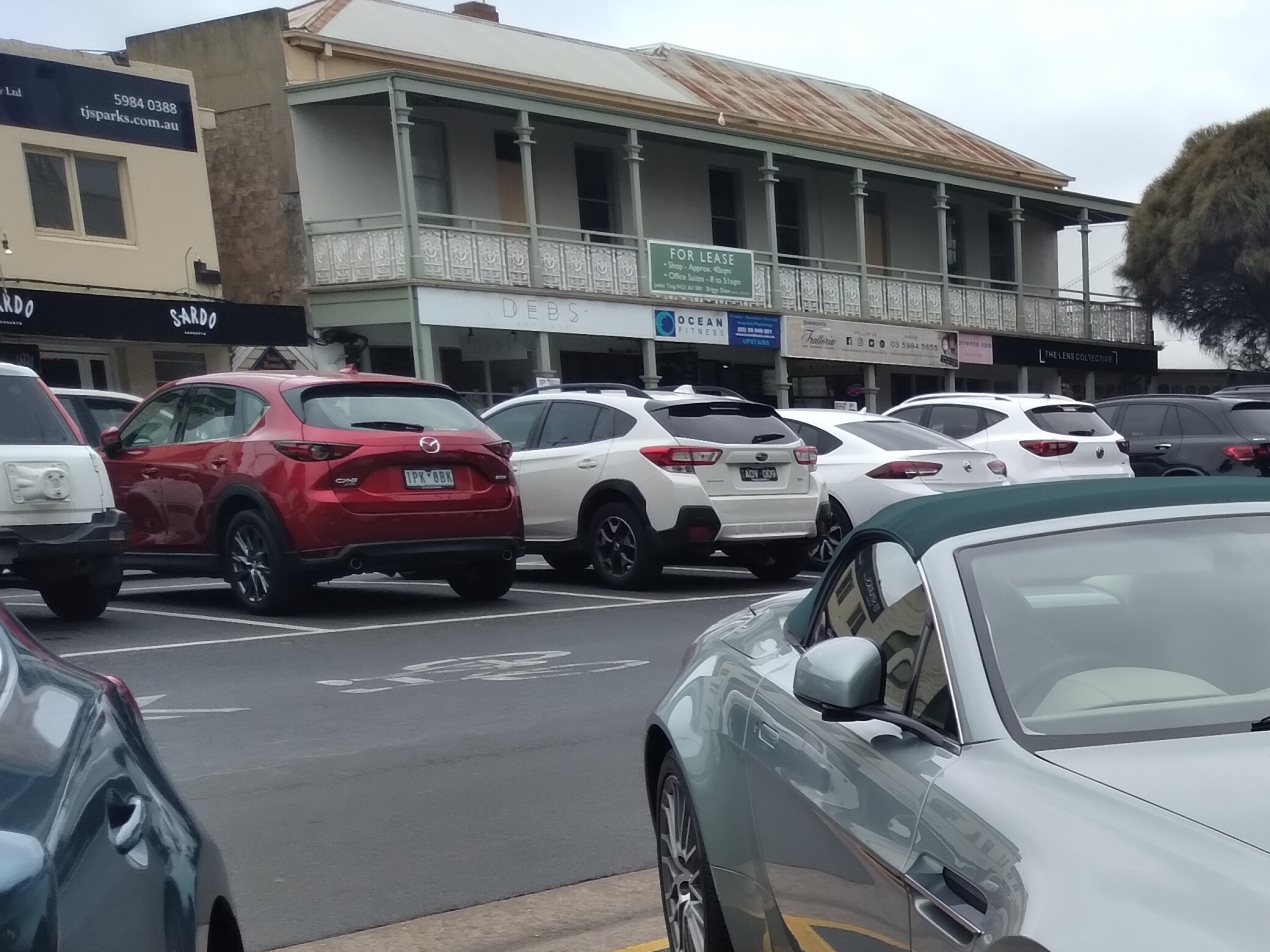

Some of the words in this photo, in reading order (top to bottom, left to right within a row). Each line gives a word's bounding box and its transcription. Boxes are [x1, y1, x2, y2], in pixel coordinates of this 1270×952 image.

[5, 87, 22, 98] Ltd
[114, 94, 144, 109] 5984
[148, 100, 177, 114] 0388
[80, 106, 179, 131] tjsparks.com.au
[670, 248, 694, 261] FOR
[701, 251, 734, 265] LEASE
[668, 262, 682, 270] Shop
[669, 272, 686, 280] Office
[0, 293, 34, 318] RDO
[503, 298, 578, 322] DEBS
[170, 306, 217, 329] SARDO
[678, 316, 722, 327] OCEAN
[679, 327, 724, 336] FITNESS
[1045, 350, 1057, 358] THE
[1059, 352, 1074, 360] LENS
[406, 472, 426, 484] 1PK
